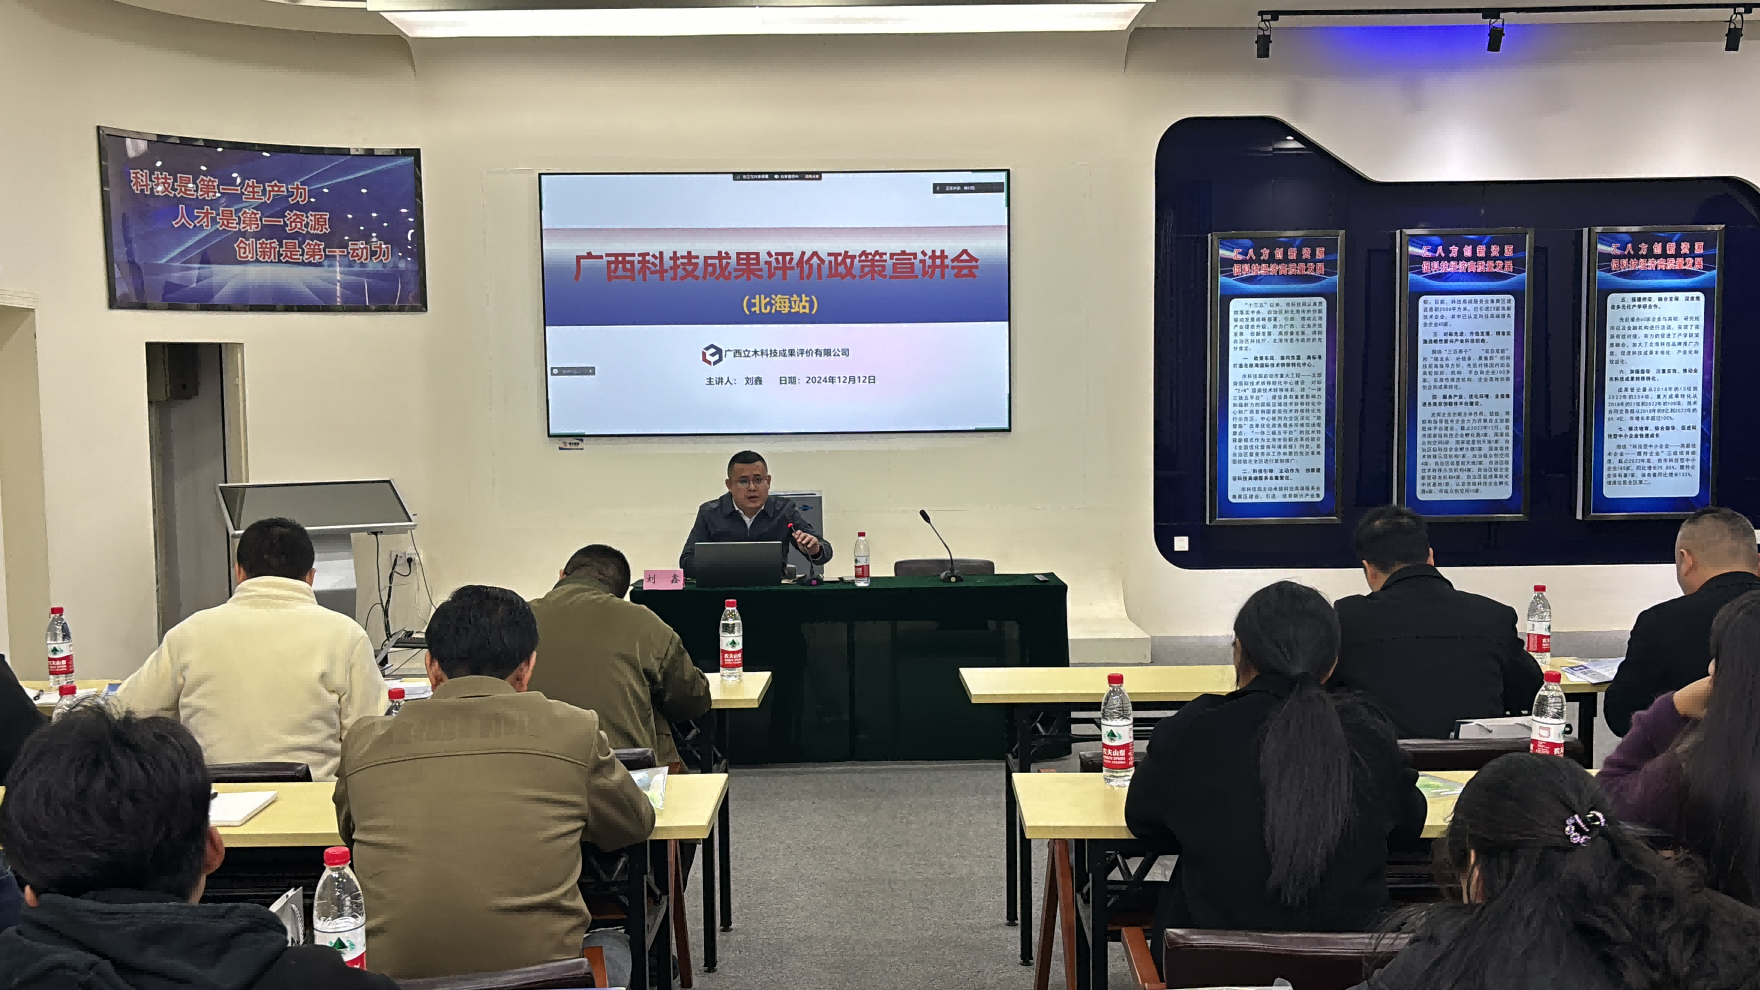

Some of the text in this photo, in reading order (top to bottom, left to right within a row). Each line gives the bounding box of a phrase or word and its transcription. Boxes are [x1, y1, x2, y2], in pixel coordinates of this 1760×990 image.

[131, 170, 308, 204] 科技是第一生产力
[173, 205, 330, 234] 人才是第一资源
[235, 238, 392, 263] 创新是第一动力
[574, 249, 979, 283] 广西科技成果评价政策宣讲会
[1232, 263, 1325, 275] 促科技经济高质量发展
[1421, 260, 1514, 273] 促科技经济高质量发展
[1611, 258, 1704, 270] 促科技经济高质量发展
[724, 348, 850, 358] 广西立木科技成果评价有限公司
